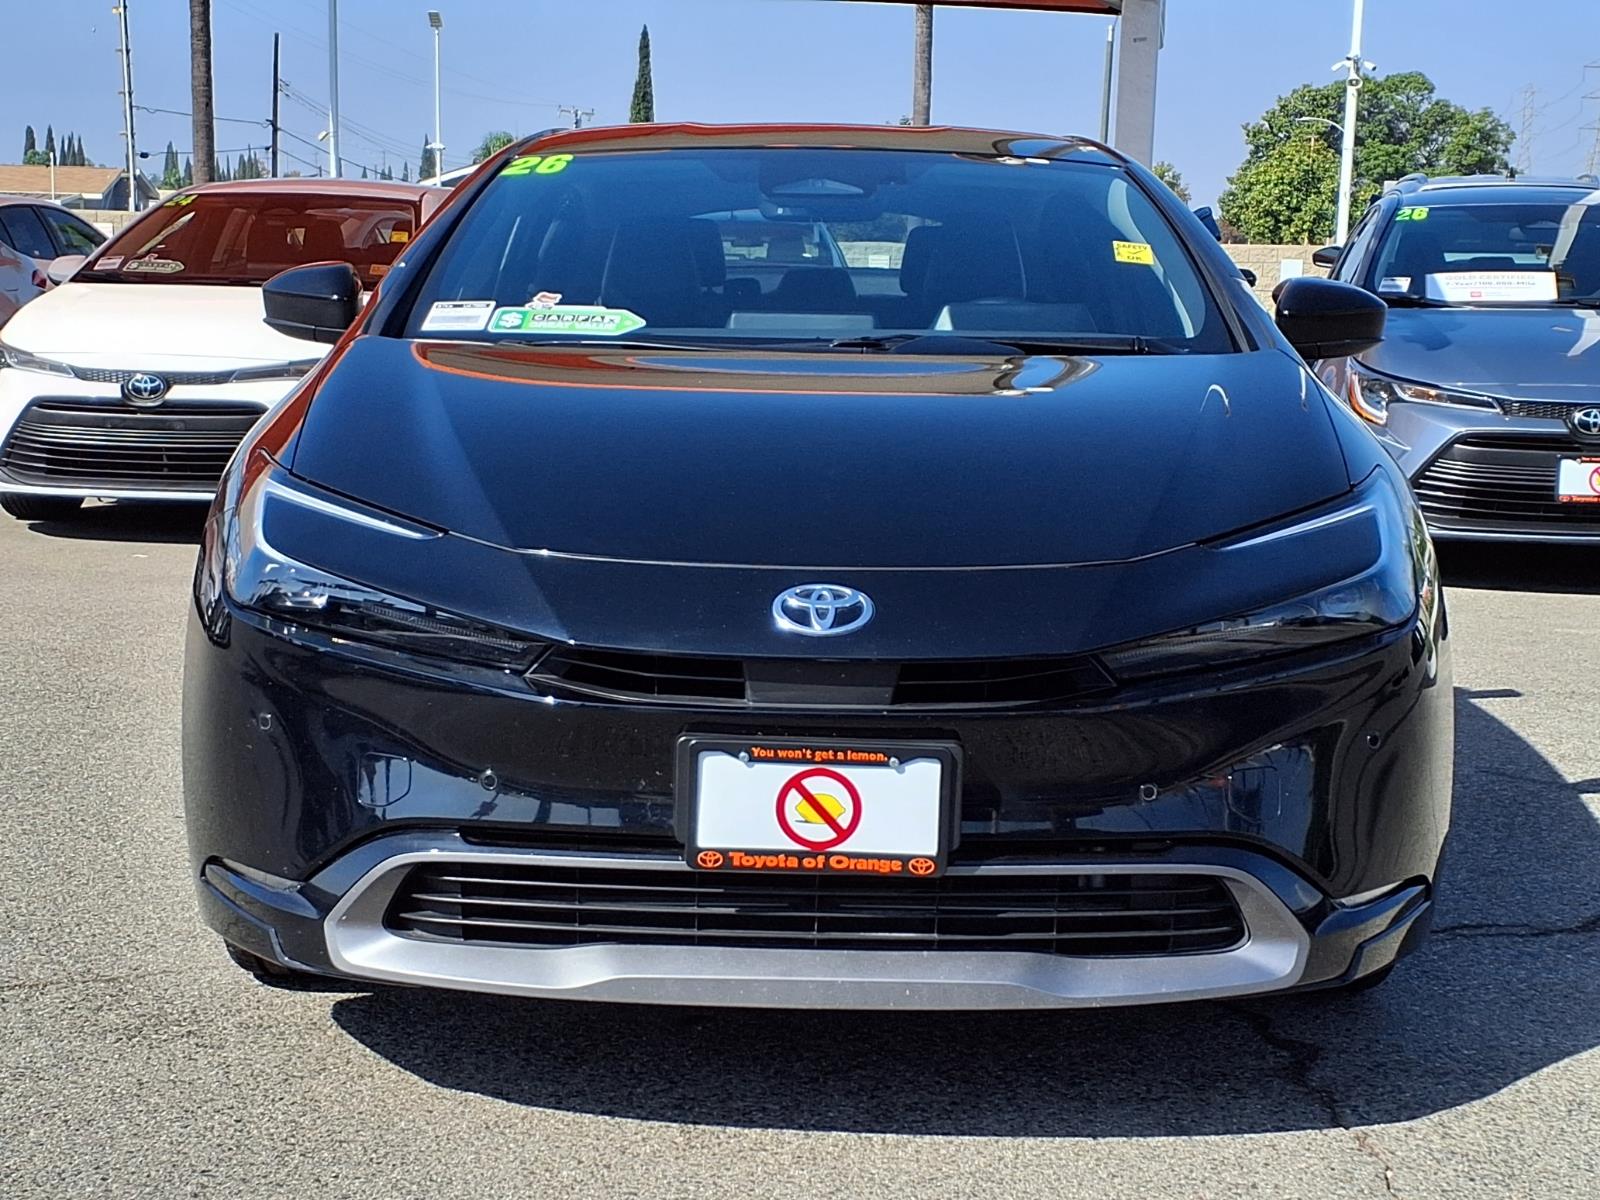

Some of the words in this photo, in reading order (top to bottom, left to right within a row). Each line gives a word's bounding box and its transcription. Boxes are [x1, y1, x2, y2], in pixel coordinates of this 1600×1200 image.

[500, 153, 575, 176] 26
[1395, 207, 1430, 221] 26
[531, 313, 616, 324] CARFAX
[751, 747, 774, 758] You
[777, 748, 812, 759] won't
[814, 750, 834, 762] get
[836, 751, 845, 760] a
[847, 750, 888, 762] lemon.
[729, 851, 798, 868] Toyota
[802, 854, 825, 868] of
[829, 855, 902, 873] Orange
